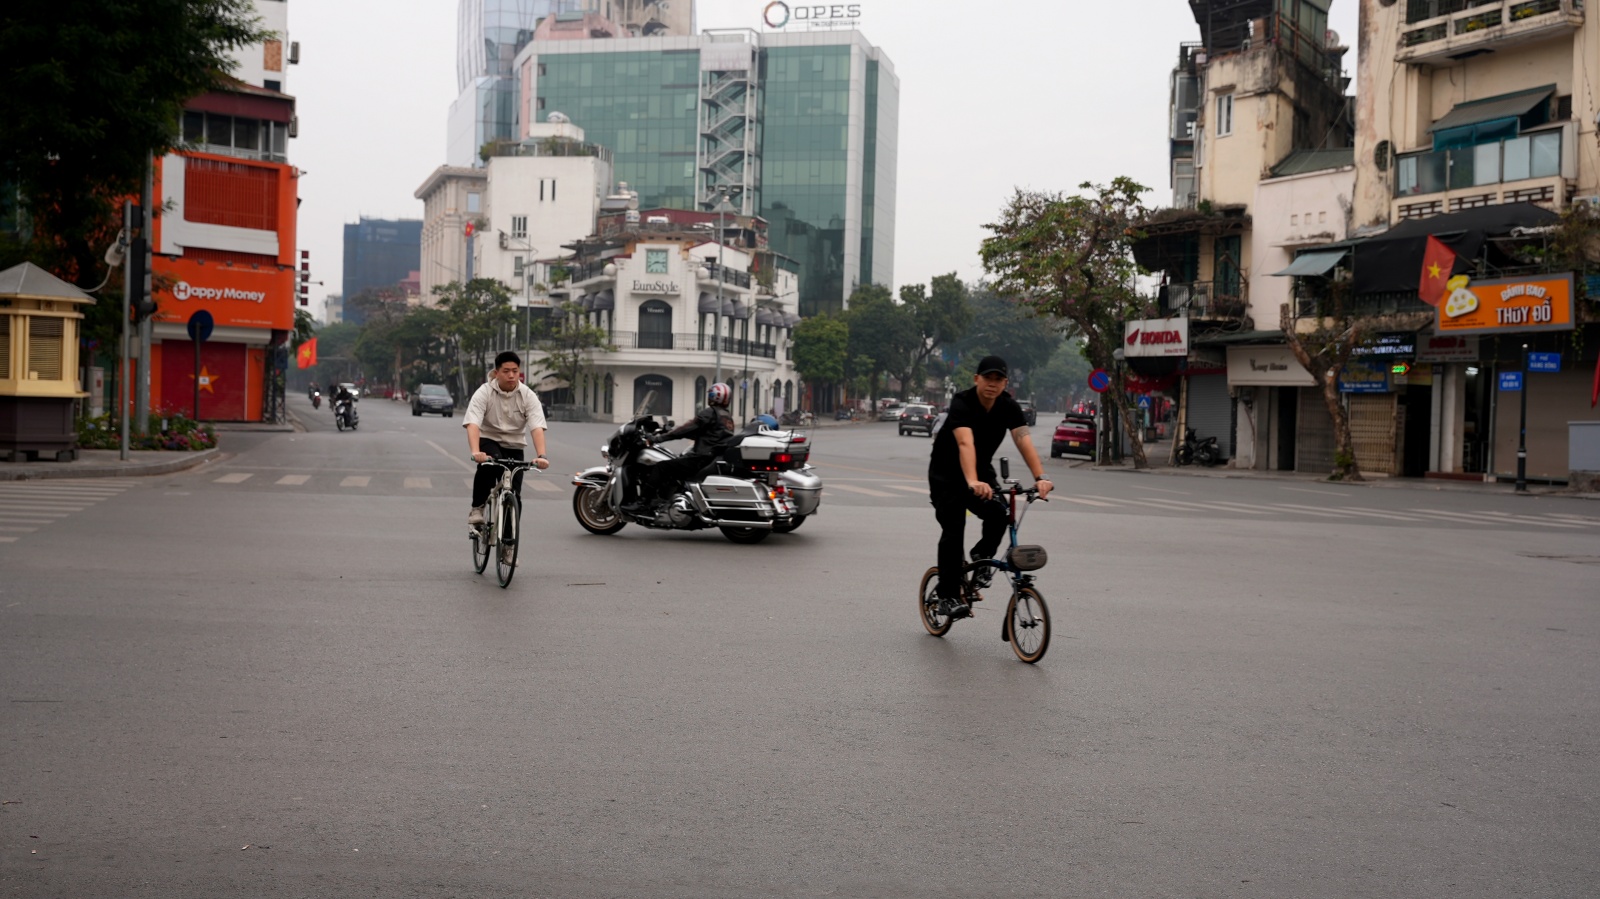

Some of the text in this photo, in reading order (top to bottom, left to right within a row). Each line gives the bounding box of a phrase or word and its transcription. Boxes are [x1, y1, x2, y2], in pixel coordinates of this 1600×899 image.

[794, 4, 861, 19] OPES
[173, 281, 266, 303] Happy Money
[632, 280, 679, 294] EuroStyle
[1525, 284, 1547, 299] BAO
[1140, 330, 1182, 345] HONDA
